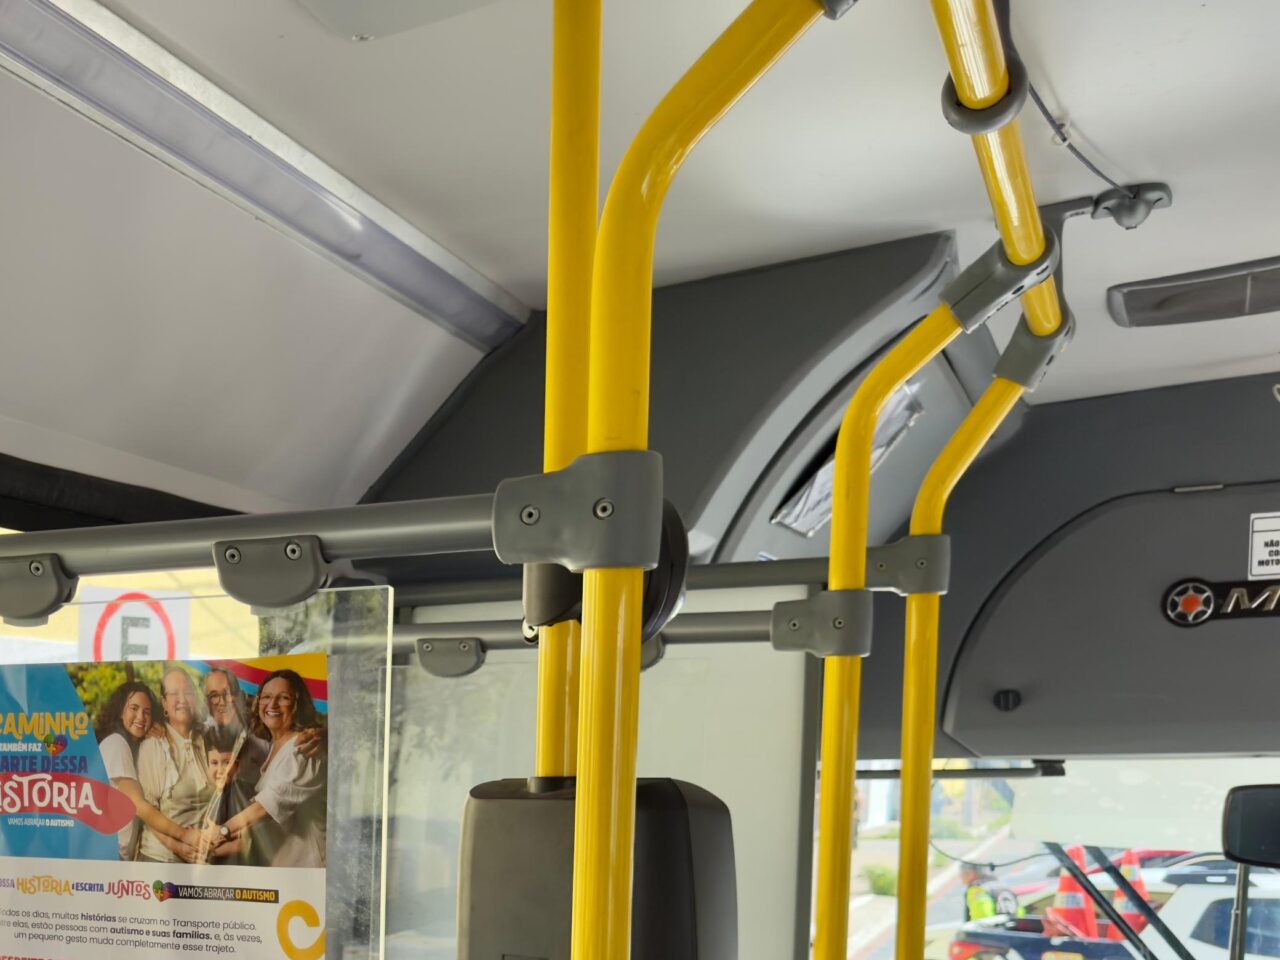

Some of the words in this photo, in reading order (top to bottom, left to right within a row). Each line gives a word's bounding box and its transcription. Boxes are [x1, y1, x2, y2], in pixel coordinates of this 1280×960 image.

[0, 741, 27, 752] TAMBÉM
[28, 743, 42, 752] FAZ
[40, 755, 88, 773] DESSA
[50, 819, 74, 827] AUTISMO
[76, 882, 104, 893] ESCRITA
[178, 887, 203, 898] VAMOS
[204, 889, 234, 900] ABRAÇAR
[236, 891, 241, 899] O
[242, 891, 275, 900] AUTISMO
[32, 911, 51, 920] dias,
[81, 913, 117, 922] histórias
[172, 919, 220, 931] Transporte
[222, 921, 257, 931] público.
[13, 921, 30, 930] elas,
[31, 922, 53, 930] estão
[55, 924, 88, 933] pessoas
[110, 926, 144, 935] autismo
[172, 929, 213, 940] famílias.
[224, 931, 235, 941] às
[236, 936, 263, 944] vezes,
[28, 932, 64, 942] pequeno
[65, 935, 88, 944] gesto
[89, 936, 114, 945] muda
[116, 938, 181, 950] completamente
[205, 944, 236, 955] trajeto.
